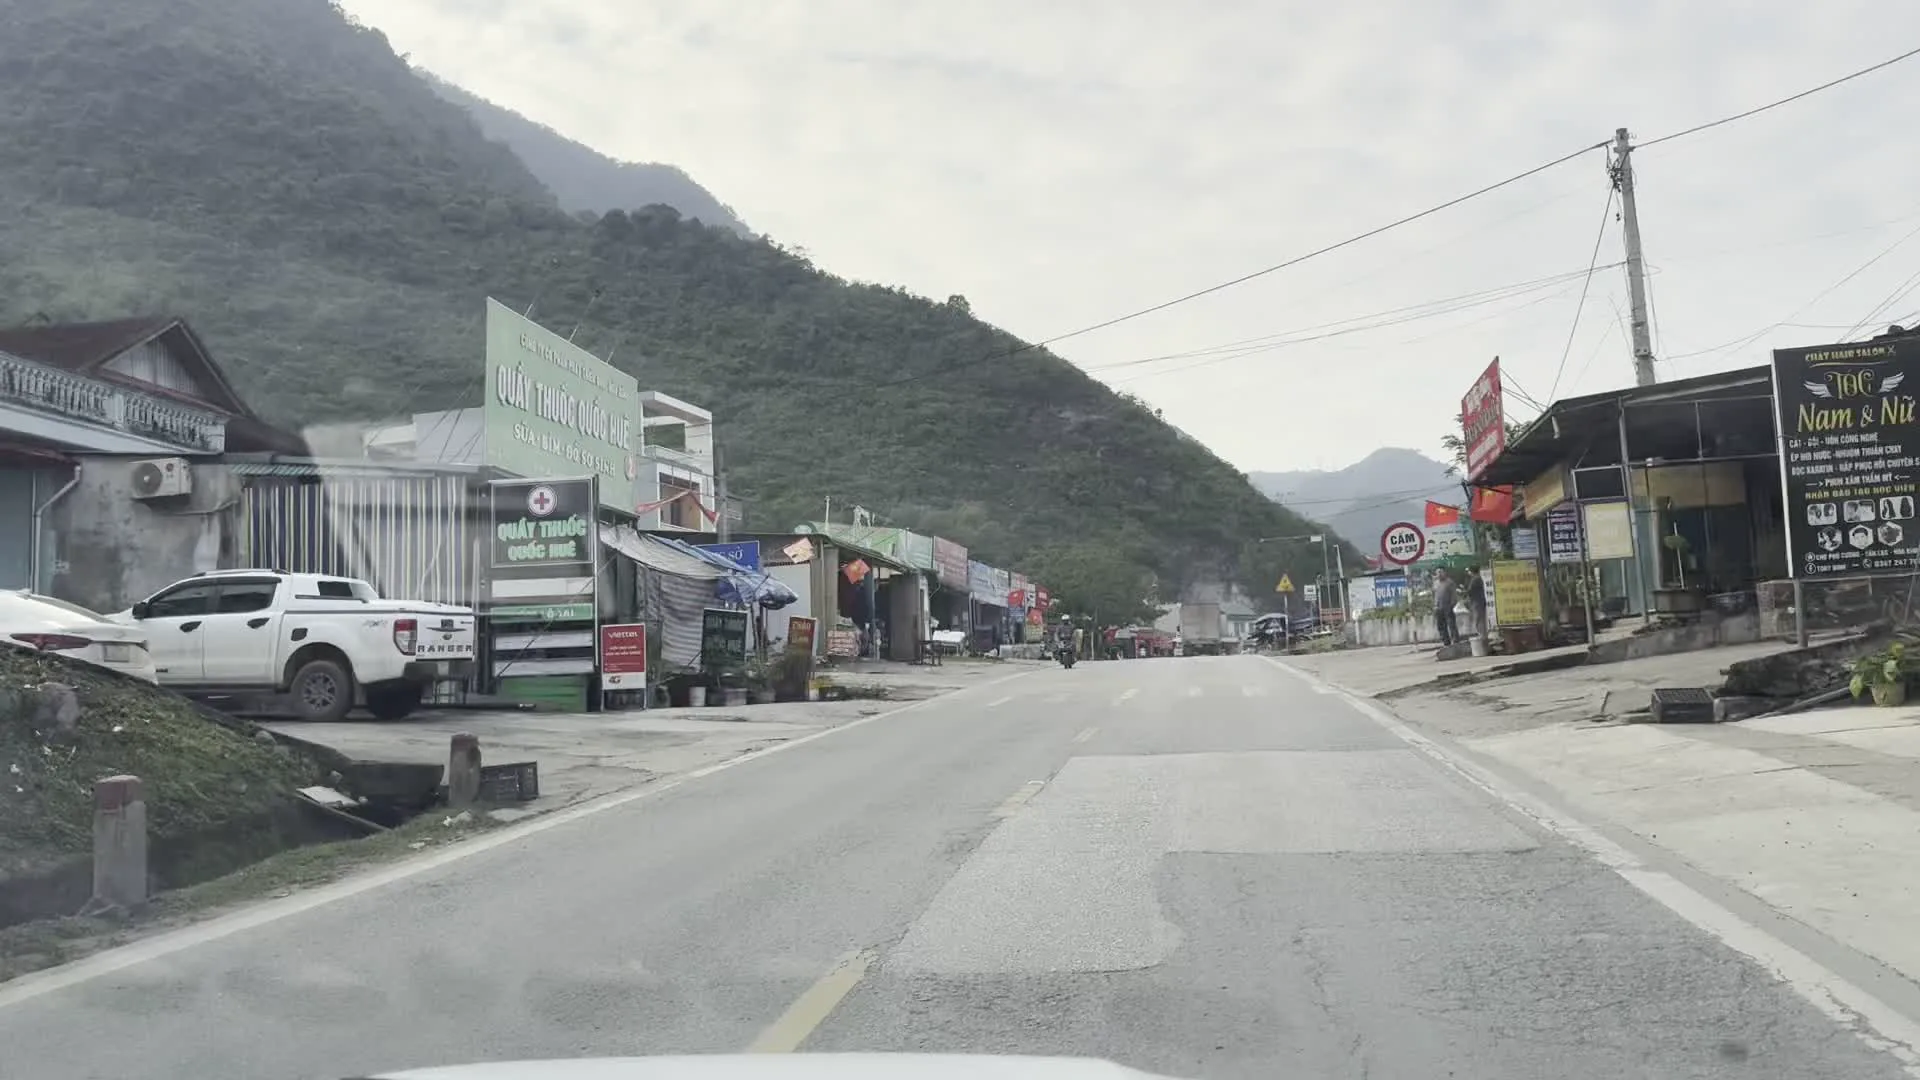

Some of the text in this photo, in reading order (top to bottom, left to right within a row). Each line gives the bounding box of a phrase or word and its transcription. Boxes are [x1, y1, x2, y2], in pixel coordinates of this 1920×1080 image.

[1857, 346, 1886, 357] SALON
[535, 382, 575, 430] THUỐC
[577, 396, 607, 440] QUỐC
[1798, 395, 1916, 433] Nam & Nữ
[1840, 433, 1859, 444] CÔNG
[540, 513, 587, 538] THUỐC
[1390, 531, 1416, 545] CẤM
[508, 540, 546, 561] QUỐC
[417, 644, 473, 653] RANGER
